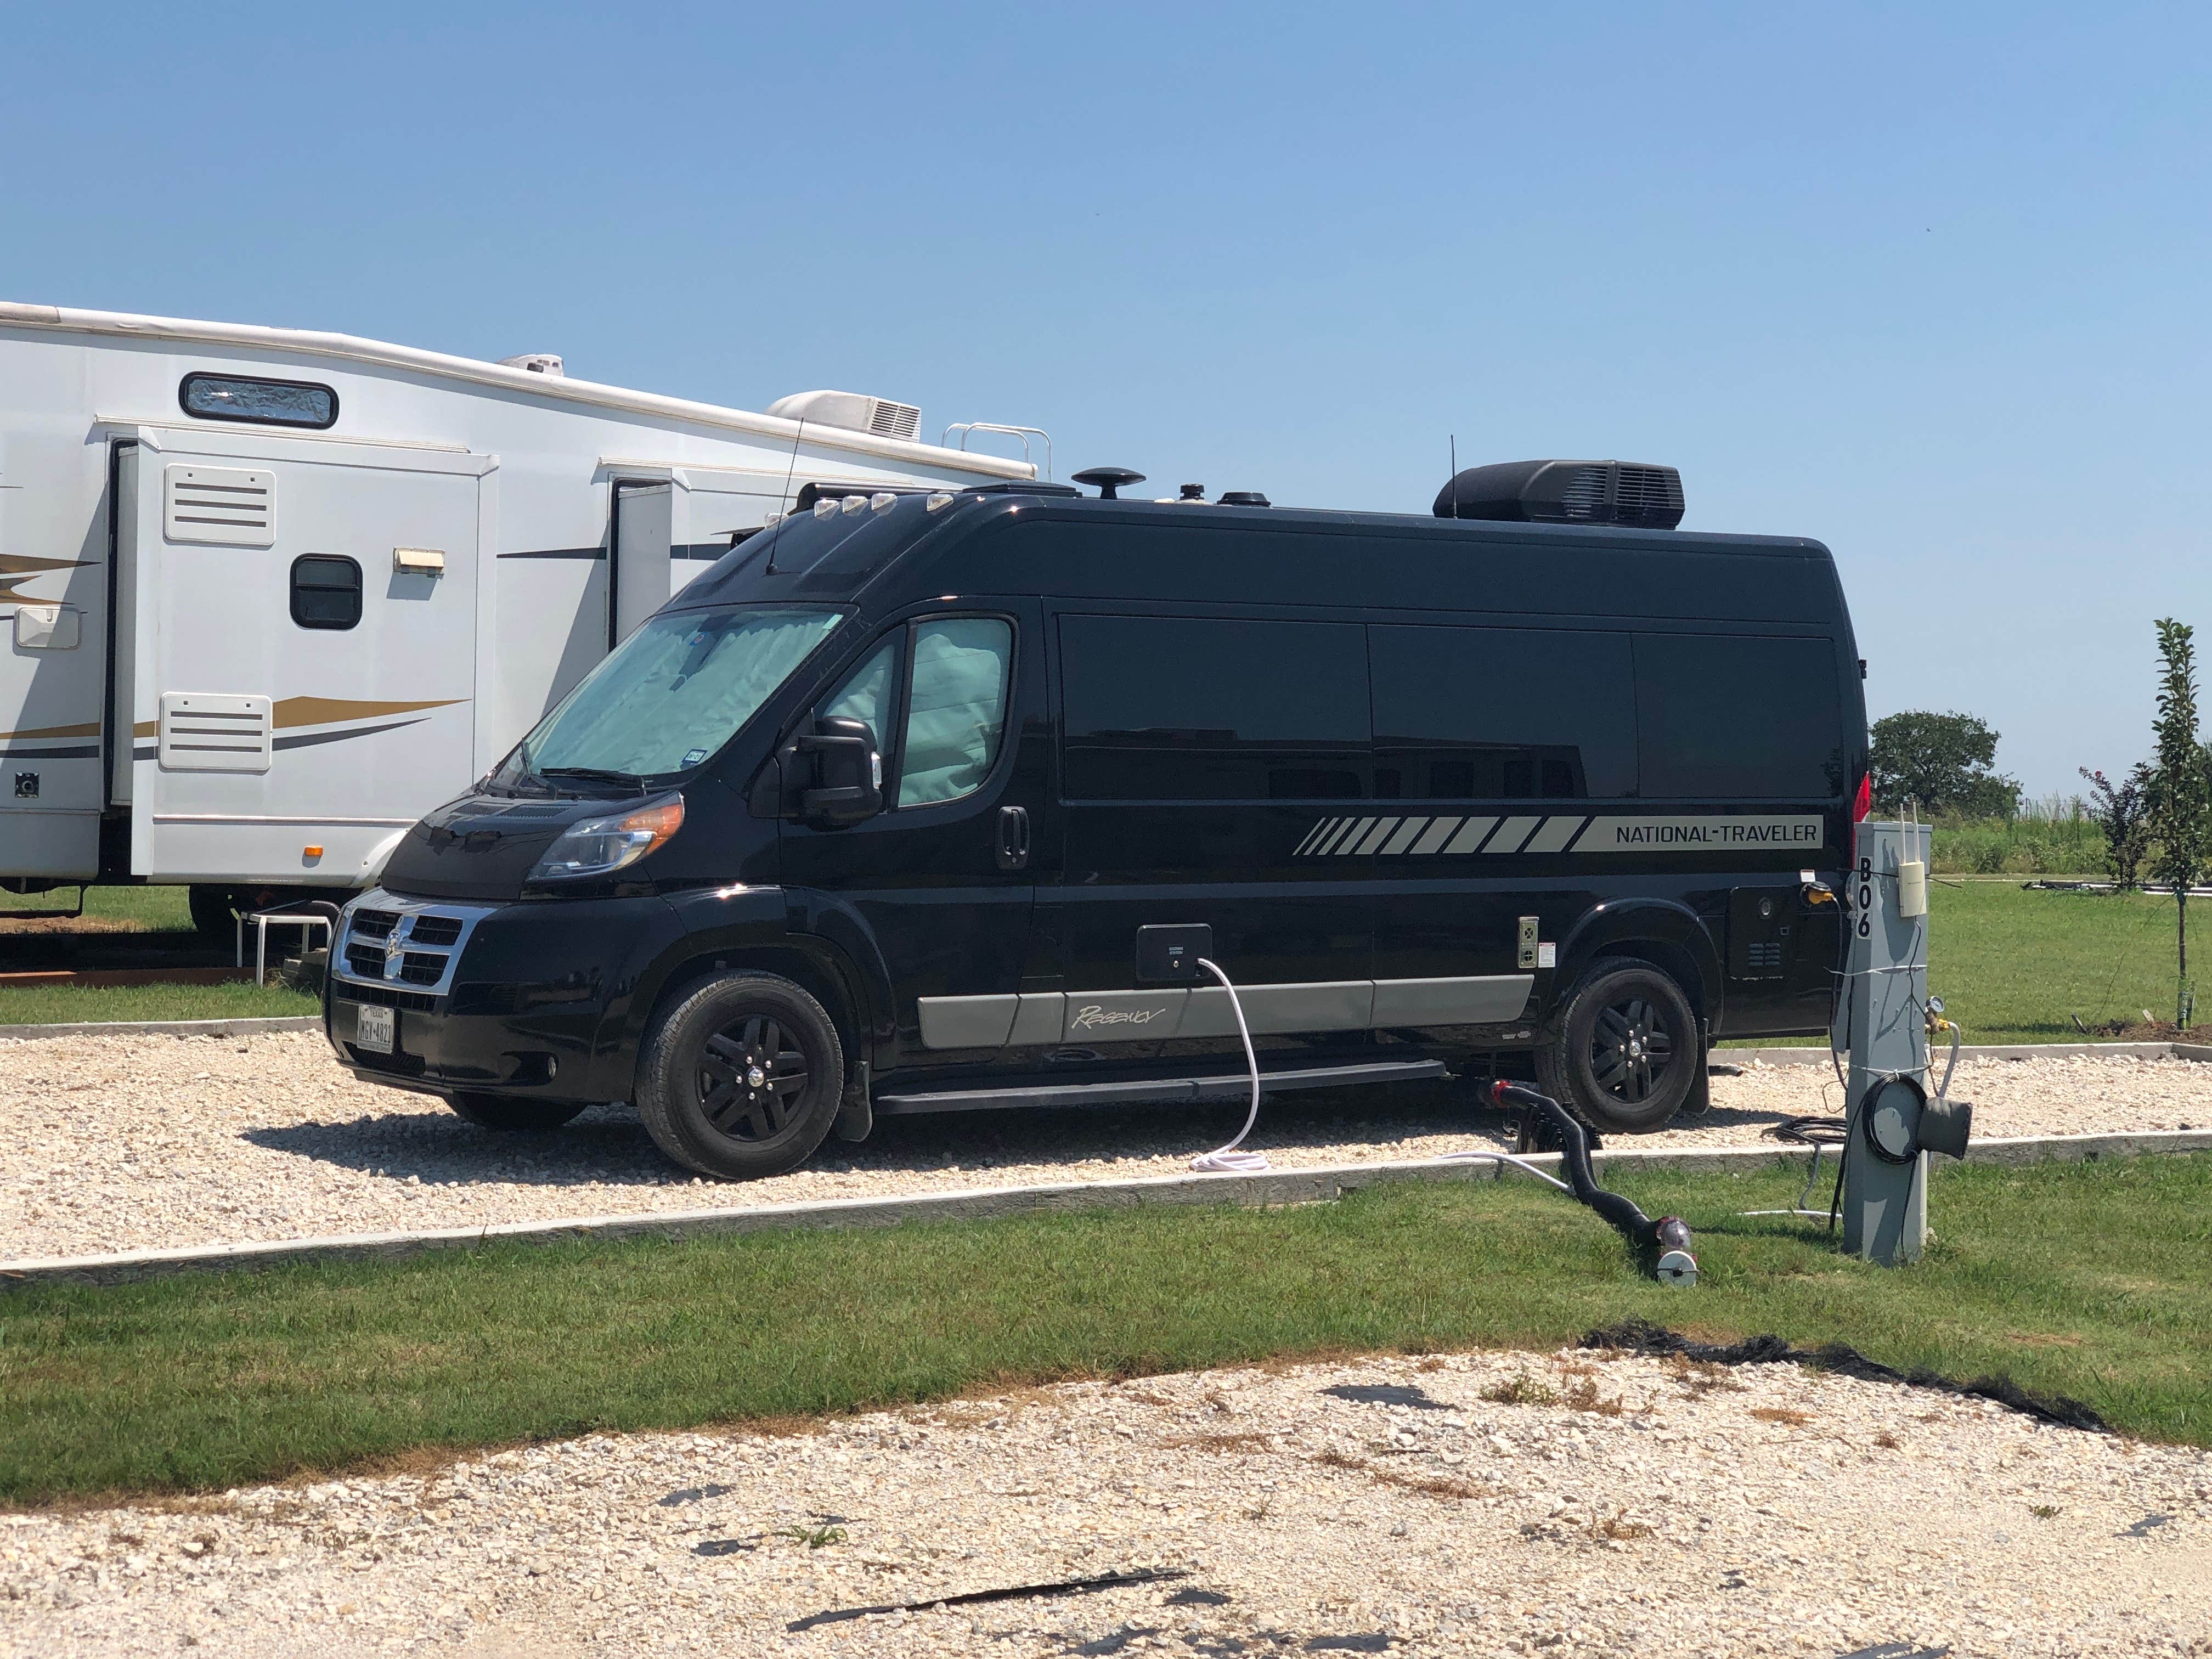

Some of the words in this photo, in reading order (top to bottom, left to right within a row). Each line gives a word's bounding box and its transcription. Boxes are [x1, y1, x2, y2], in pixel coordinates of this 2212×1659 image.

[1616, 825, 1816, 843] NATIONAL-TRAVELER
[1858, 857, 1872, 938] B06
[370, 1009, 383, 1019] TEXAS
